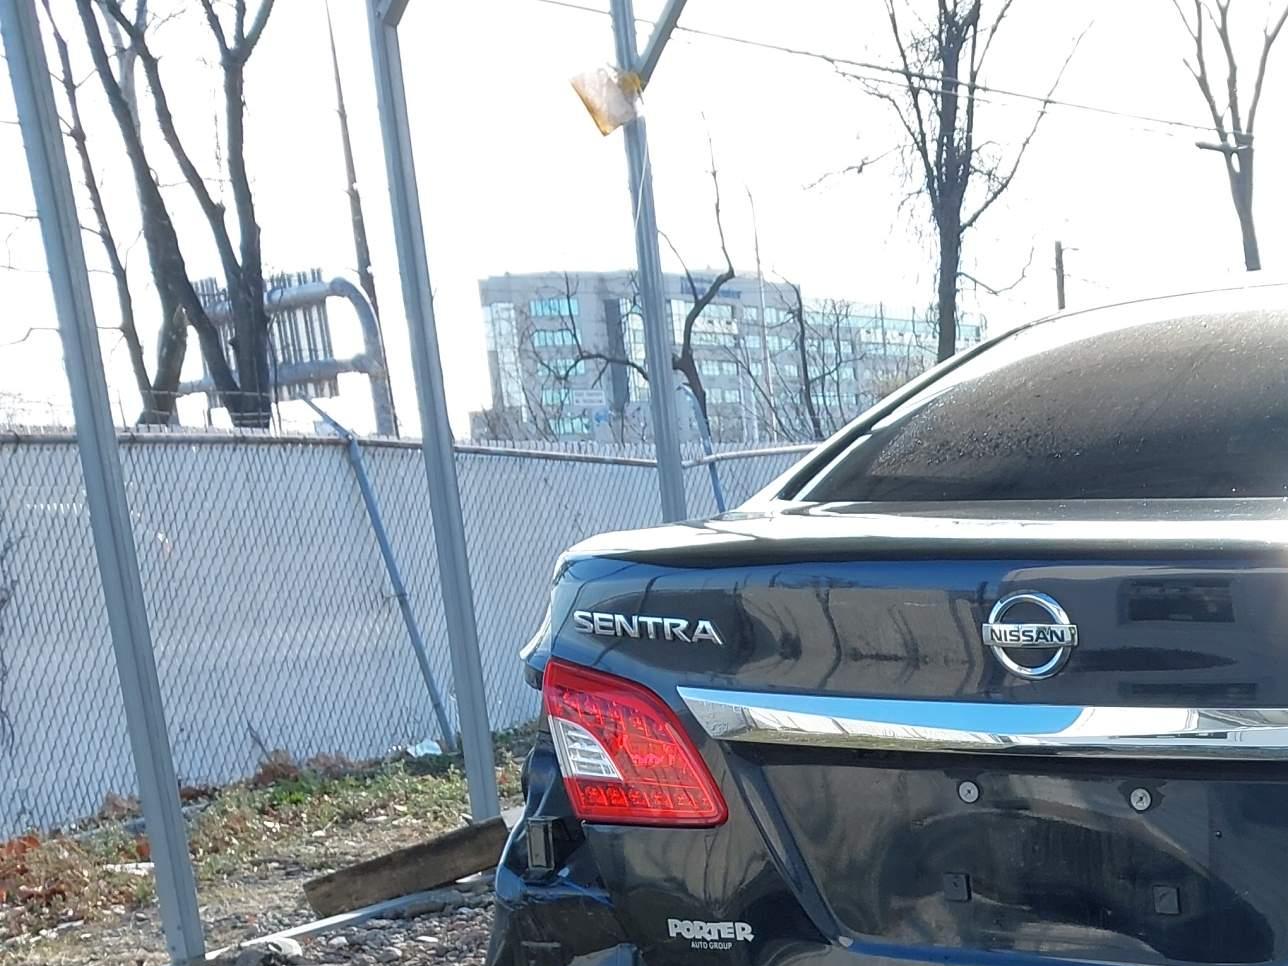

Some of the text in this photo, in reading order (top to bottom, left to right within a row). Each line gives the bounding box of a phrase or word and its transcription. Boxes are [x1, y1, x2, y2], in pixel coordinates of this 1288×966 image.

[573, 610, 723, 645] SENTRA
[990, 628, 1065, 643] NISSAN
[667, 918, 755, 942] PORTER
[691, 941, 733, 950] AUTO GROUP
